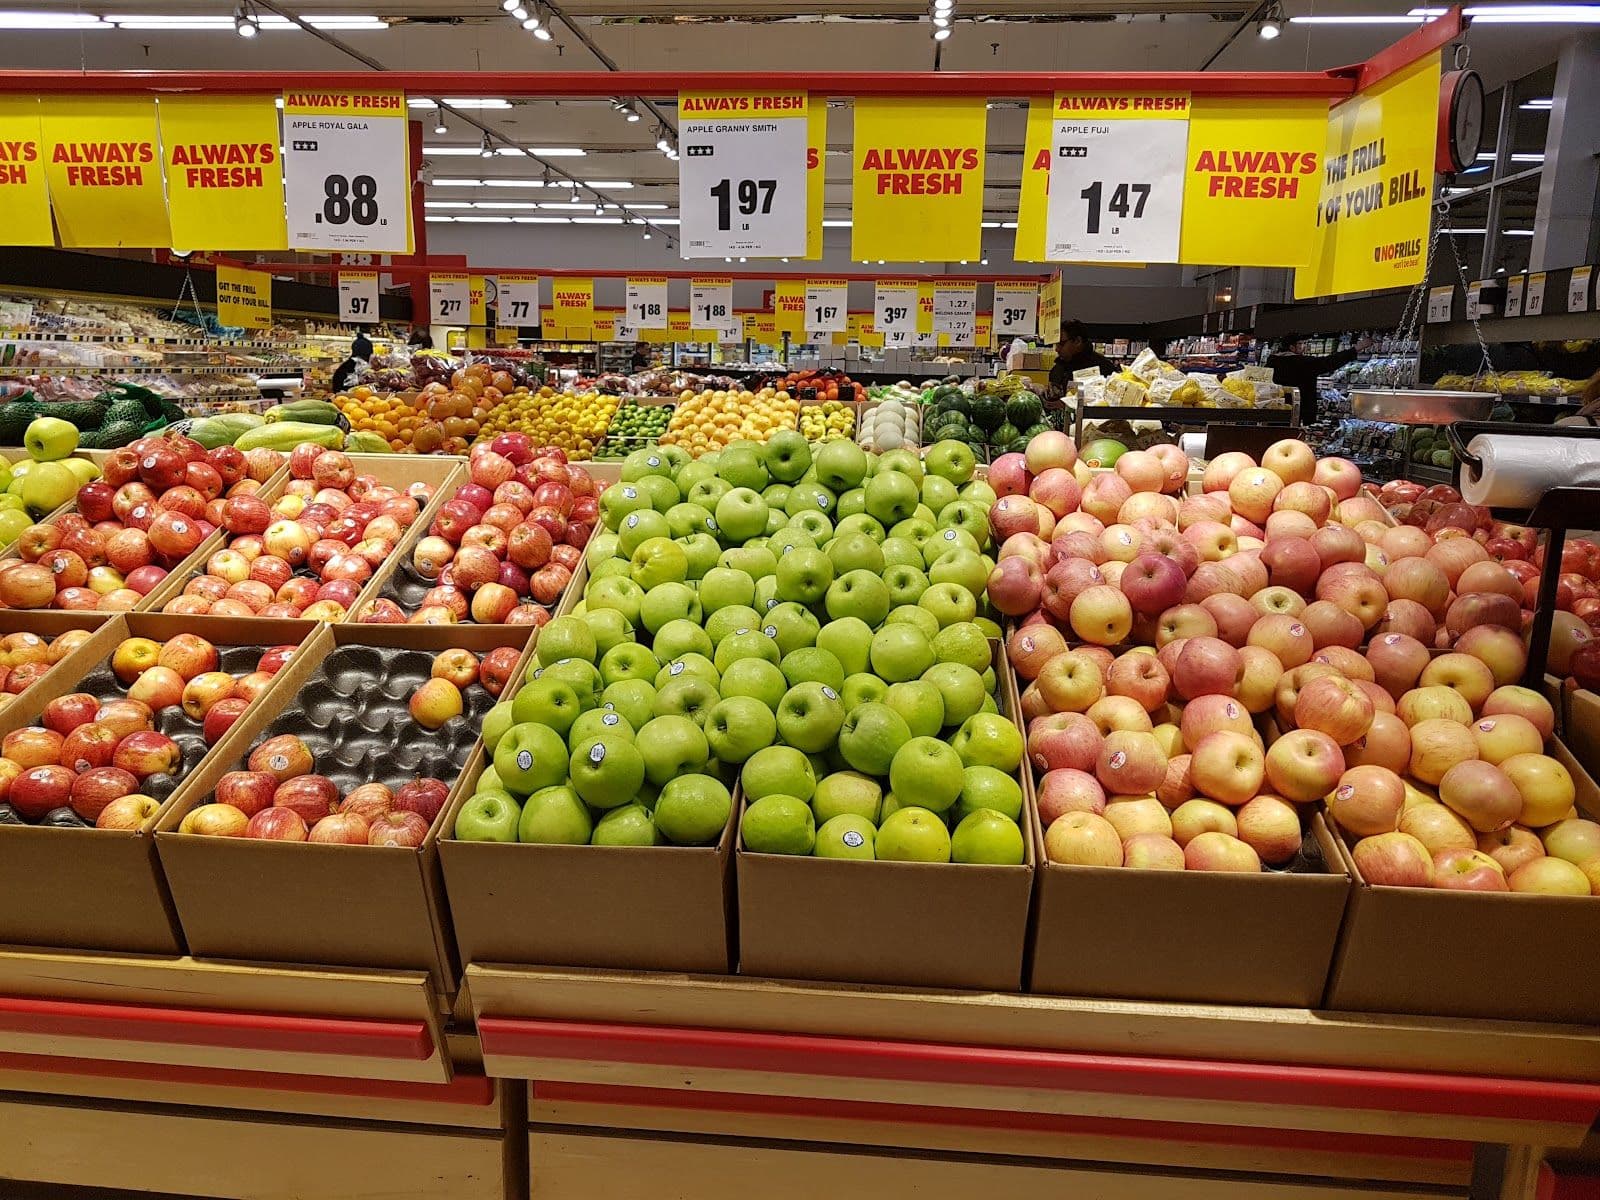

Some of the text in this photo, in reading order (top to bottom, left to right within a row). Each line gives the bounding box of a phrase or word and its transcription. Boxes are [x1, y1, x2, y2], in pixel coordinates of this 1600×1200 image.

[287, 94, 400, 109] ALWAYS FRESH
[683, 97, 803, 111] ALWAYS FRESH
[1059, 97, 1186, 111] ALWAYS FRESH
[292, 121, 368, 130] APPLE ROYAL GALA
[687, 124, 777, 133] APPLE GRANNY SMITH
[1061, 126, 1109, 134] APPLE FUJI
[53, 143, 152, 162] ALWAYS
[172, 144, 274, 165] ALWAYS
[862, 148, 978, 170] ALWAYS
[1195, 151, 1317, 173] ALWAYS
[1326, 137, 1386, 186] THE FRILL
[67, 166, 143, 186] FRESH
[187, 168, 263, 188] FRESH
[877, 174, 962, 195] FRESH
[1208, 177, 1298, 199] FRESH
[1325, 196, 1341, 225] OF
[1346, 182, 1384, 219] YOUR
[1388, 169, 1426, 207] BILL.
[555, 292, 591, 300] ALWAYS
